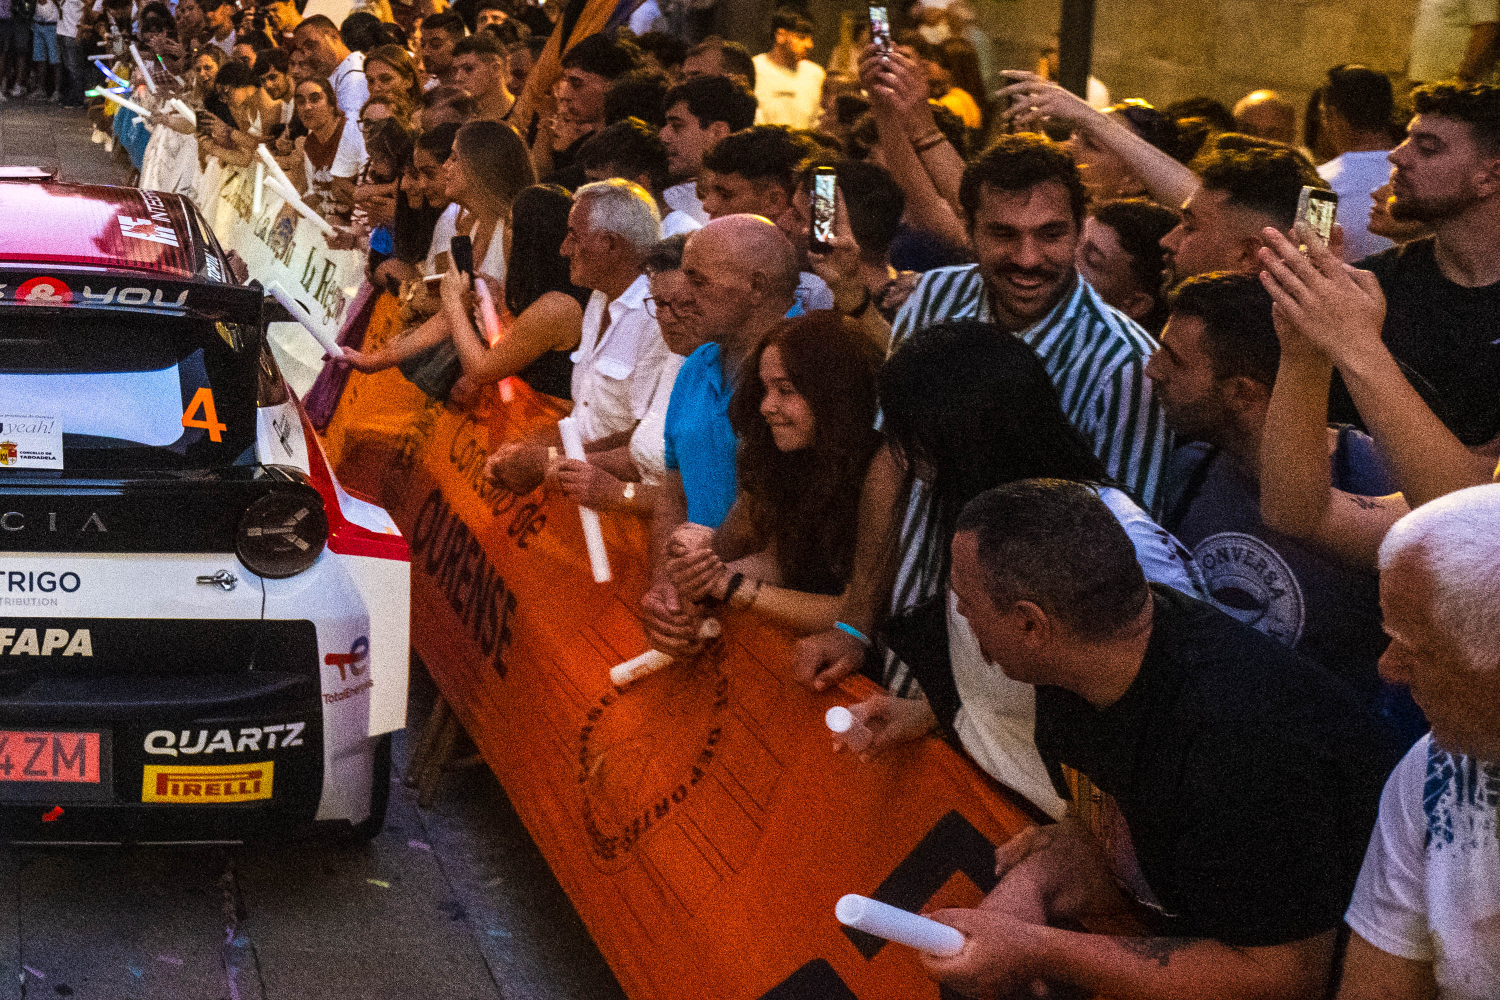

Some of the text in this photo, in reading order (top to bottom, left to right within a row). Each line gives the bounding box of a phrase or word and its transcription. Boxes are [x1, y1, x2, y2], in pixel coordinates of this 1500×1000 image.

[26, 284, 63, 303] &
[82, 284, 190, 307] YOU
[181, 387, 227, 442] 4
[411, 488, 518, 680] OURENSE
[1202, 546, 1286, 601] ONVERSA
[143, 721, 306, 758] QUARTZ
[156, 769, 263, 797] PIRELLI
